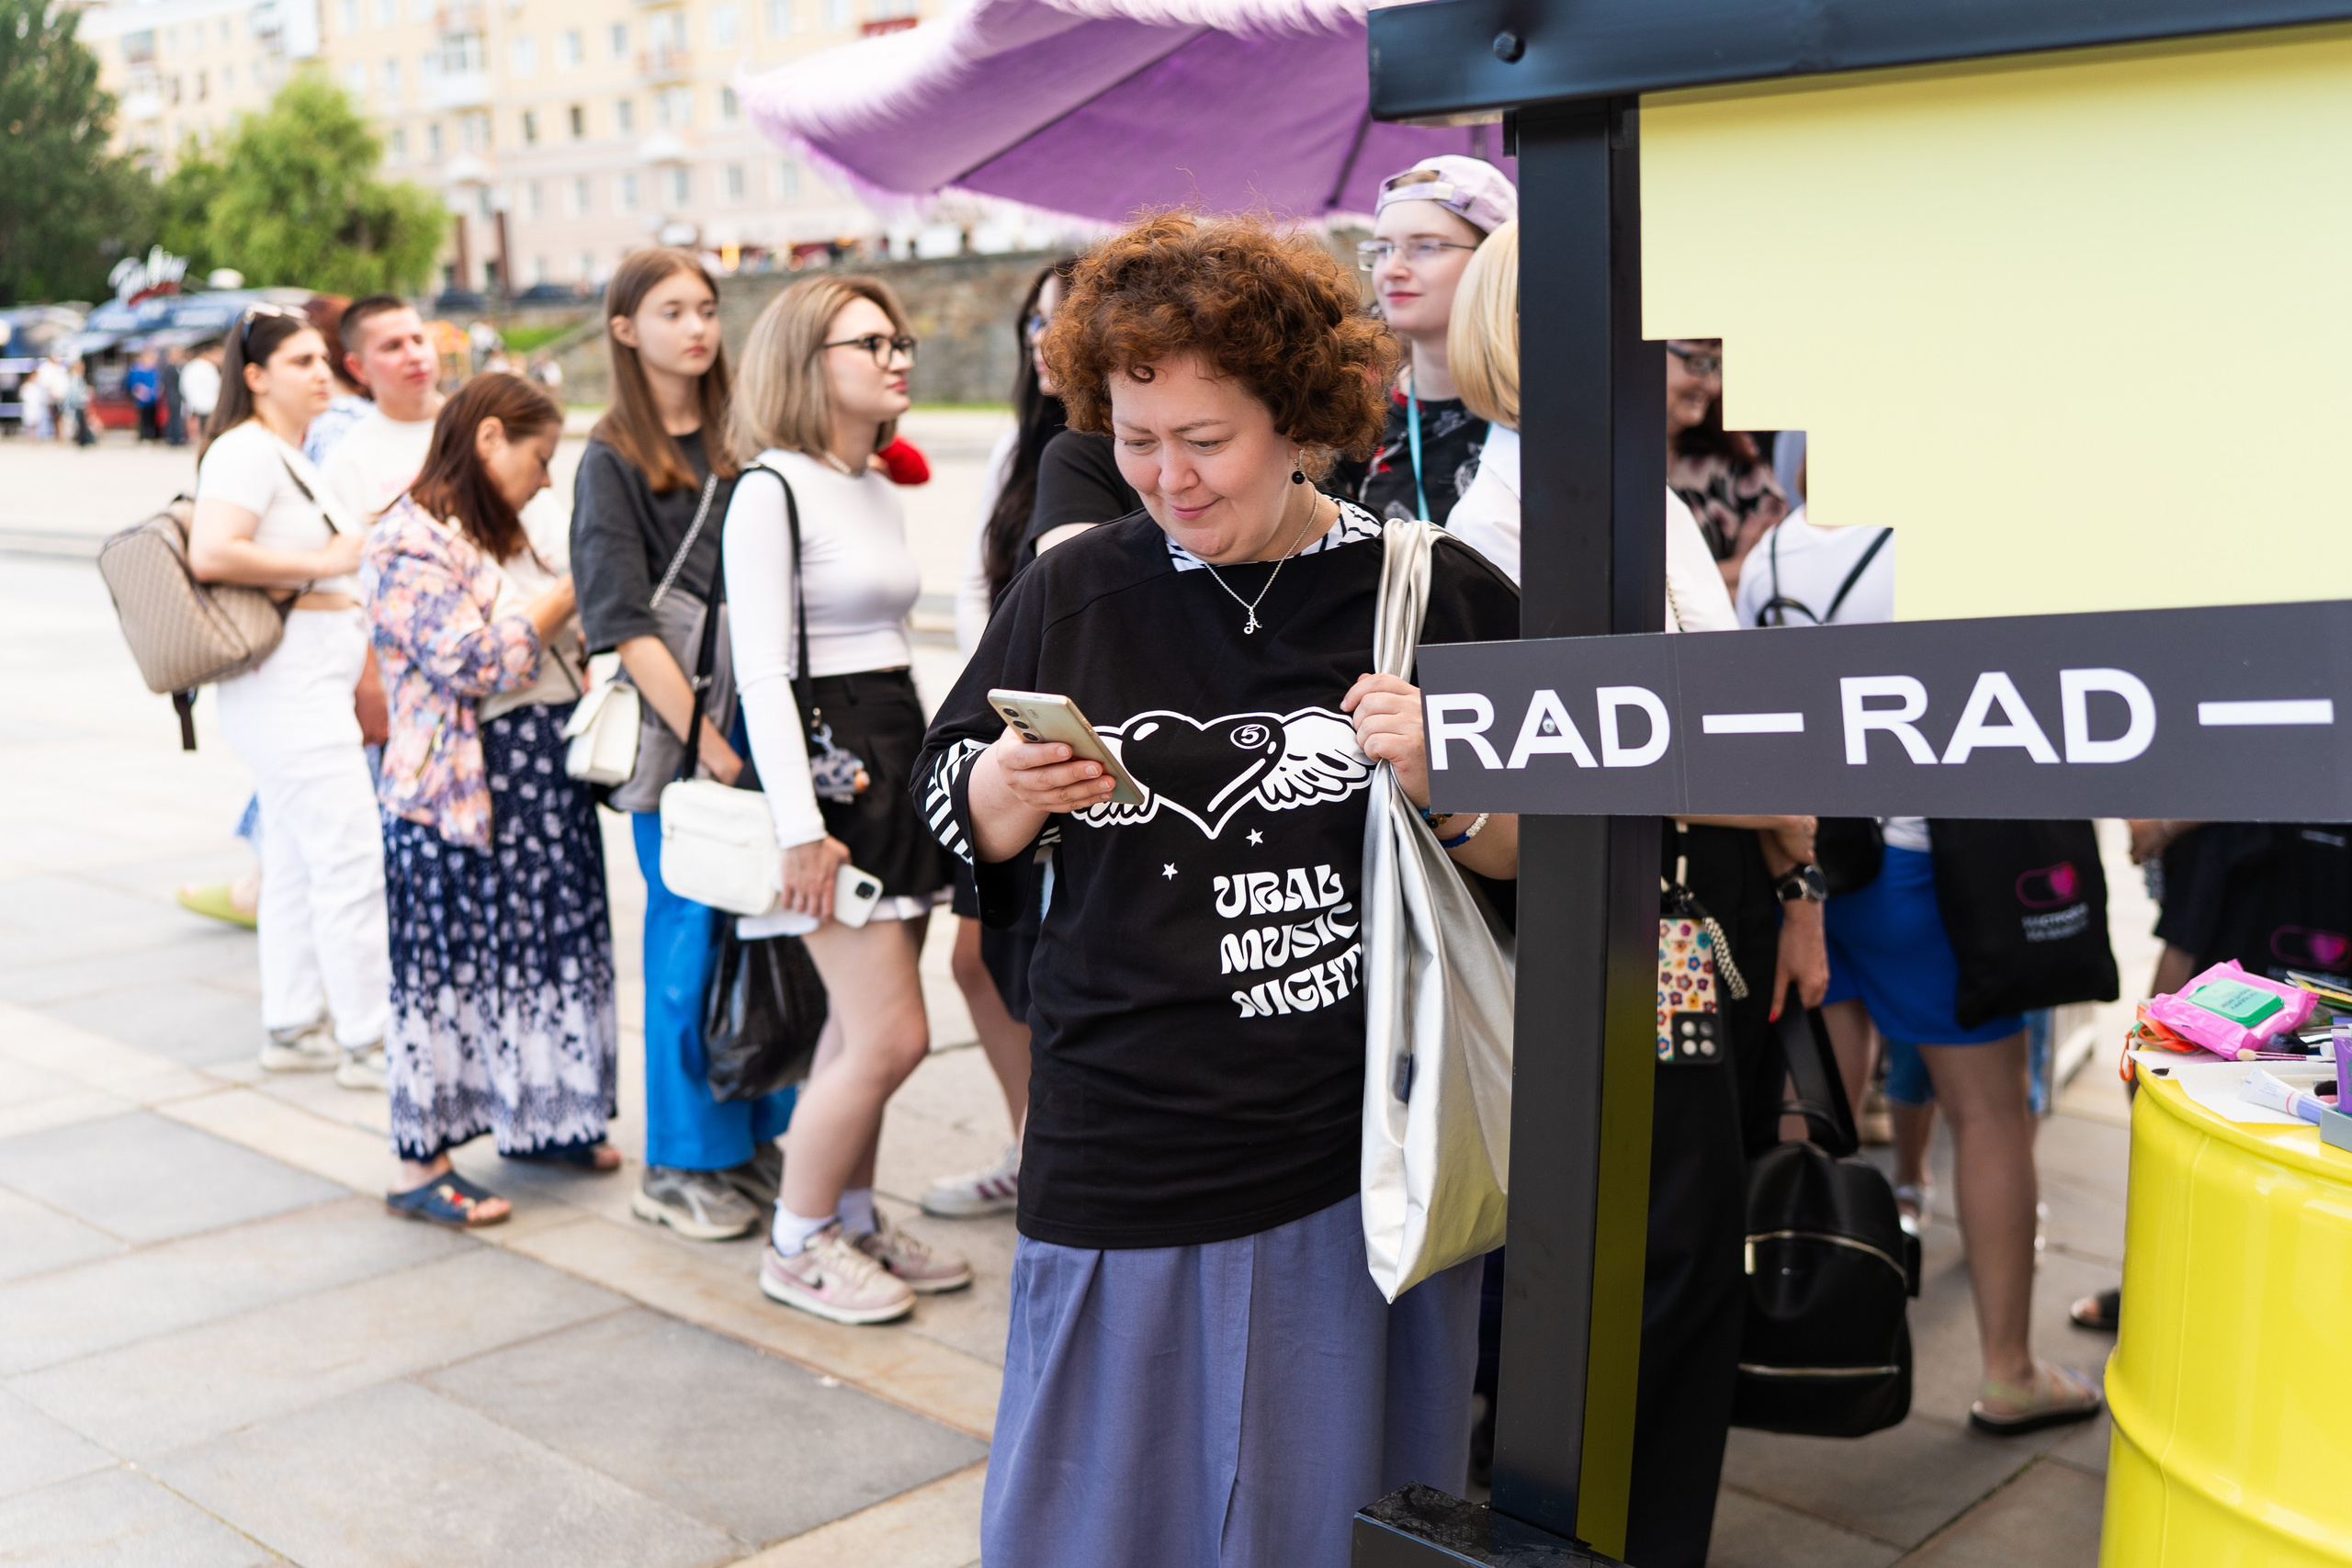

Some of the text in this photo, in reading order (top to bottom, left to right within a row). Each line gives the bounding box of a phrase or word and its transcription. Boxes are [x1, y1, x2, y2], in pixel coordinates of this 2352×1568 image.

[1240, 725, 1261, 744] 5
[1425, 685, 1671, 771] RAD
[1839, 667, 2156, 765] RAD
[1213, 864, 1344, 919] URAL
[1221, 902, 1359, 975] MUSIC
[1231, 942, 1363, 1019] NIGHT
